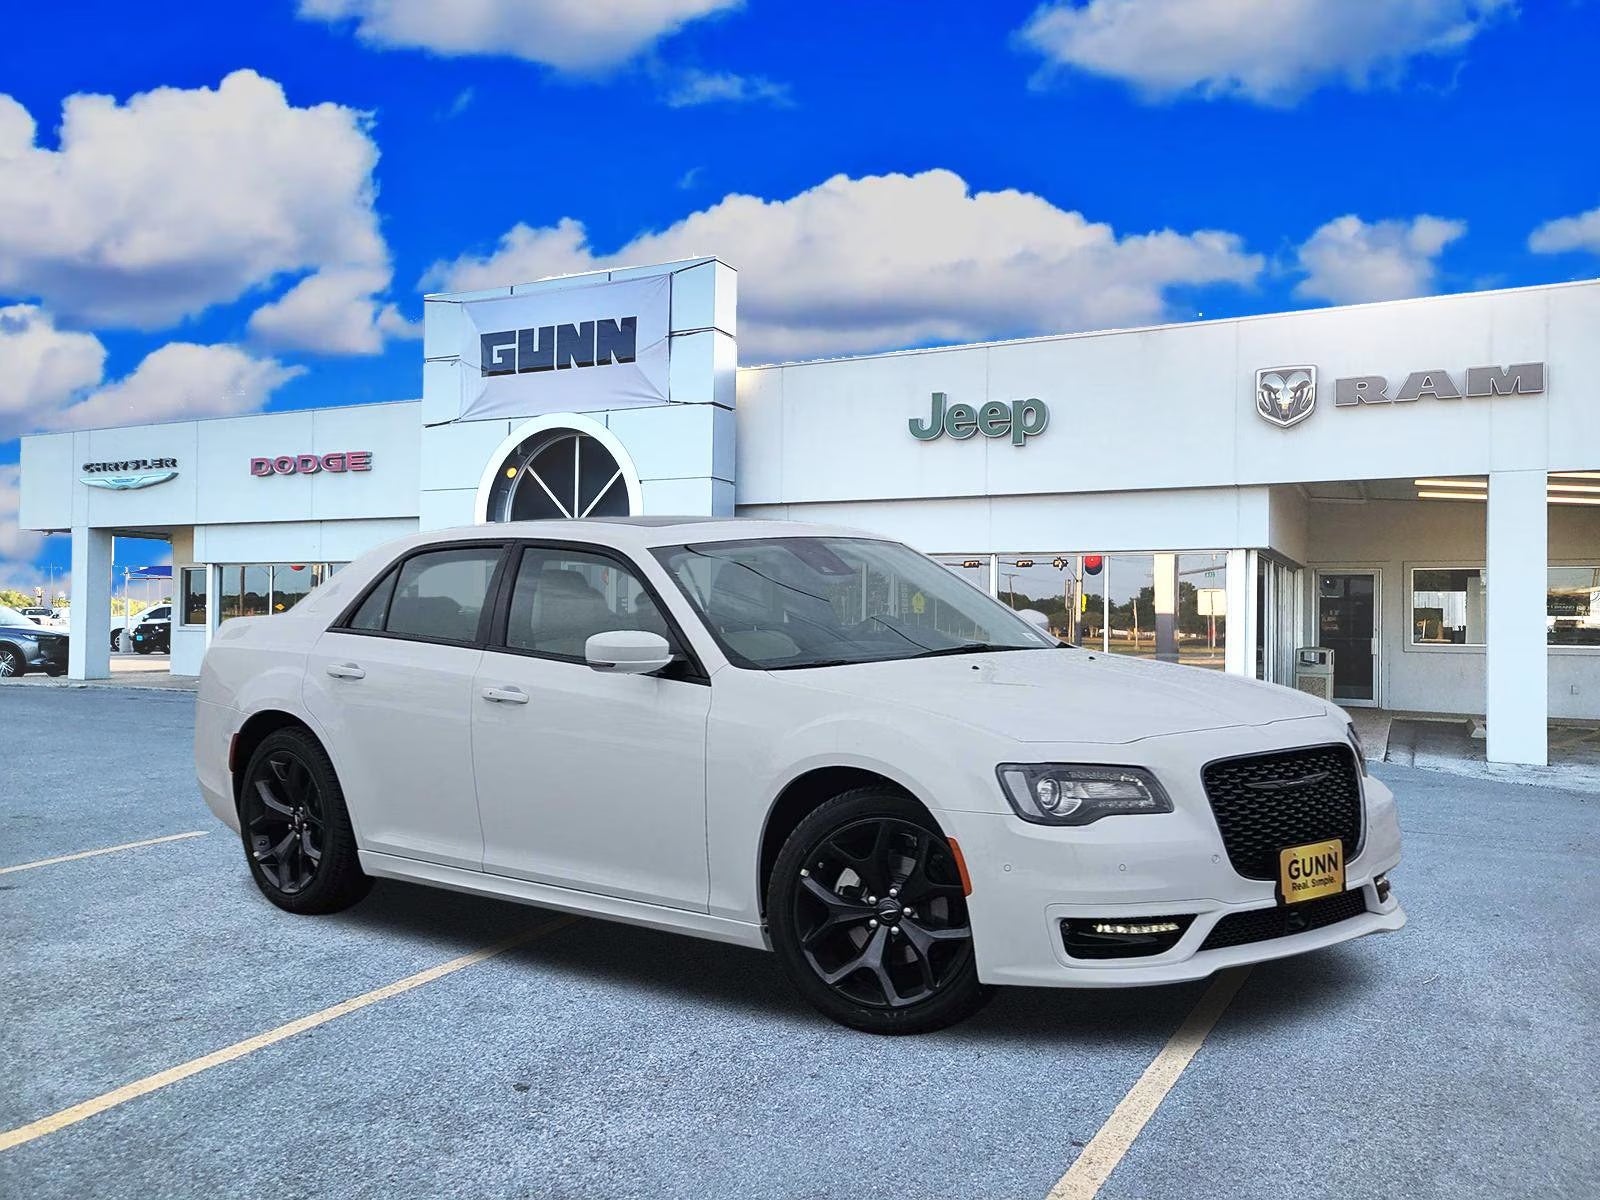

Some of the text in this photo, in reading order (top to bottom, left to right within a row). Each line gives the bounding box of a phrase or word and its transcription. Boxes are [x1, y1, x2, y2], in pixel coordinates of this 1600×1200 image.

[481, 316, 637, 378] GUNN
[1335, 362, 1545, 407] RAM
[908, 392, 1050, 447] Jeep
[82, 458, 178, 473] CHRYSLER
[250, 451, 373, 477] DODGE
[1288, 852, 1339, 880] GUNN
